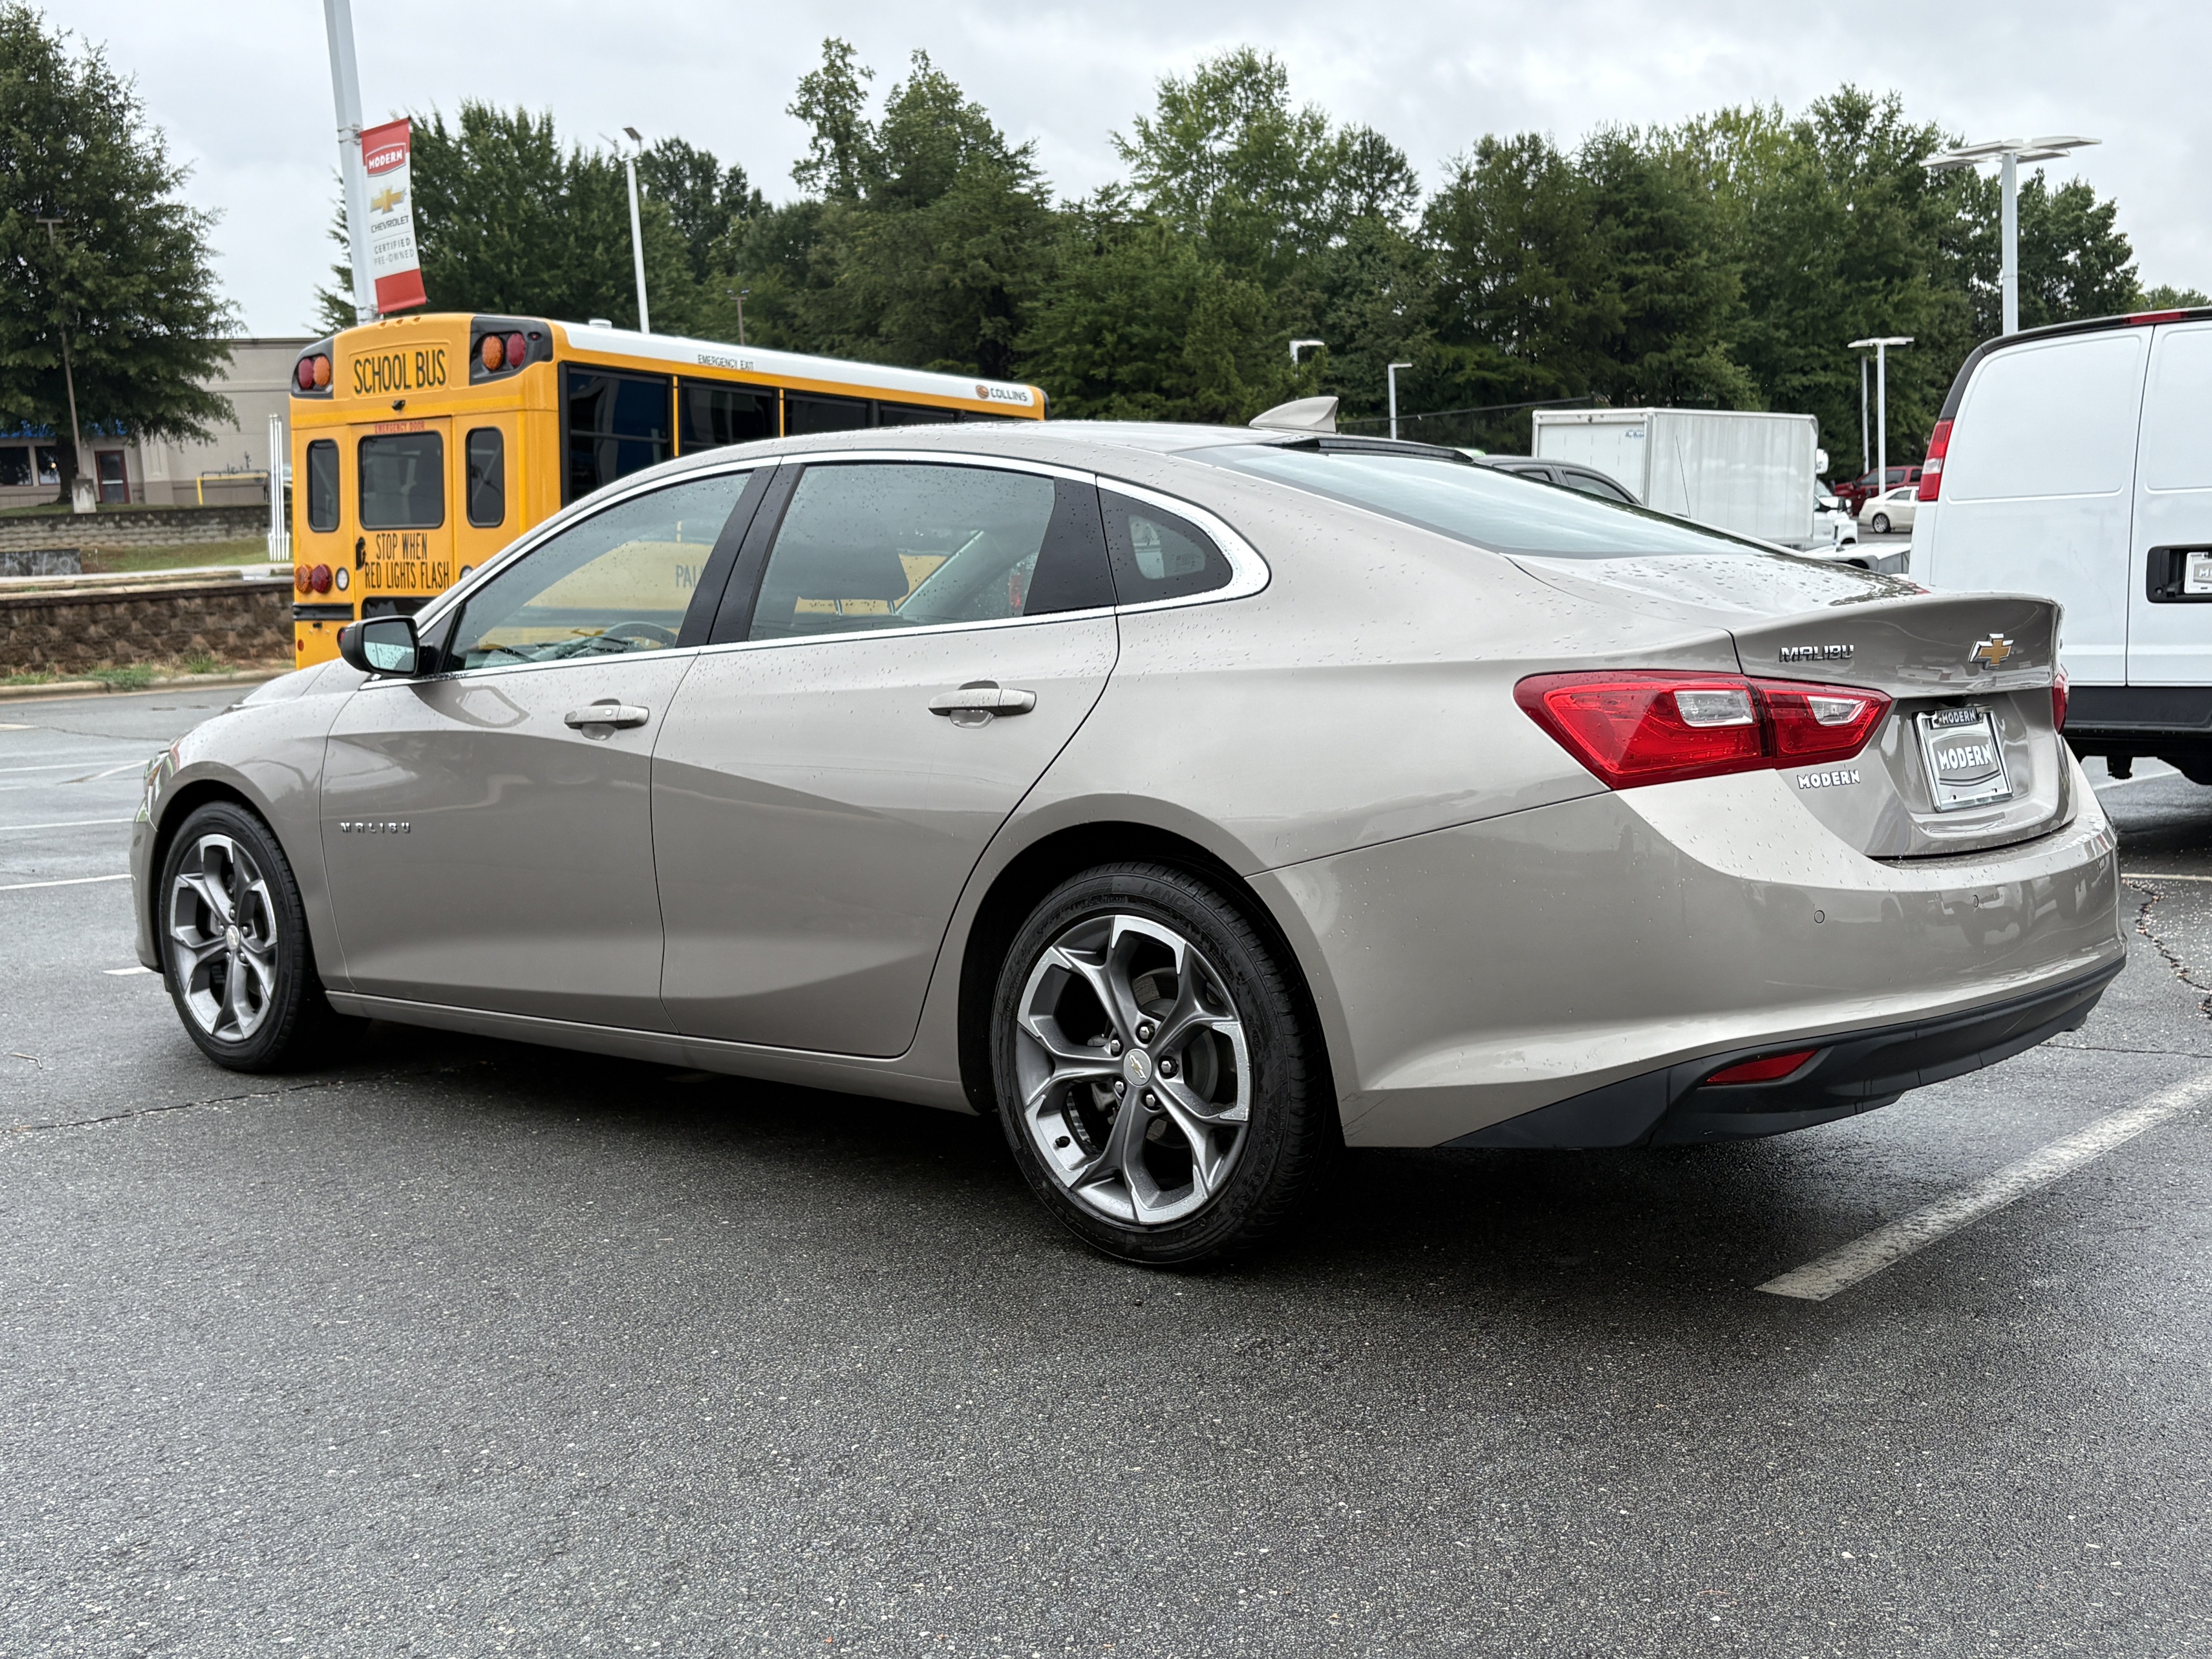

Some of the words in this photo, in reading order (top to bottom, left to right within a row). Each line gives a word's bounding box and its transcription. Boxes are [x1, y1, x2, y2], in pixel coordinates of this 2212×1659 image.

[368, 149, 403, 169] MODERN
[371, 215, 409, 234] CHEVROLET
[374, 237, 410, 254] CERTIFIED
[374, 249, 414, 266] PRE-OWNED
[354, 354, 412, 395] SCHOOL
[416, 349, 447, 388] BUS
[990, 388, 1028, 402] COLLINS
[376, 533, 398, 560] STOP
[402, 532, 427, 560] WHEN
[364, 561, 382, 589] RED
[386, 562, 416, 589] LIGHTS
[421, 561, 449, 589] FLASH
[1779, 644, 1855, 663] MALIBU
[1941, 709, 1977, 725] MODERN
[1937, 744, 1993, 771] MODERN
[1796, 769, 1860, 789] MODERN
[340, 822, 411, 834] MALIBU
[1140, 882, 1235, 953] LANCASTER
